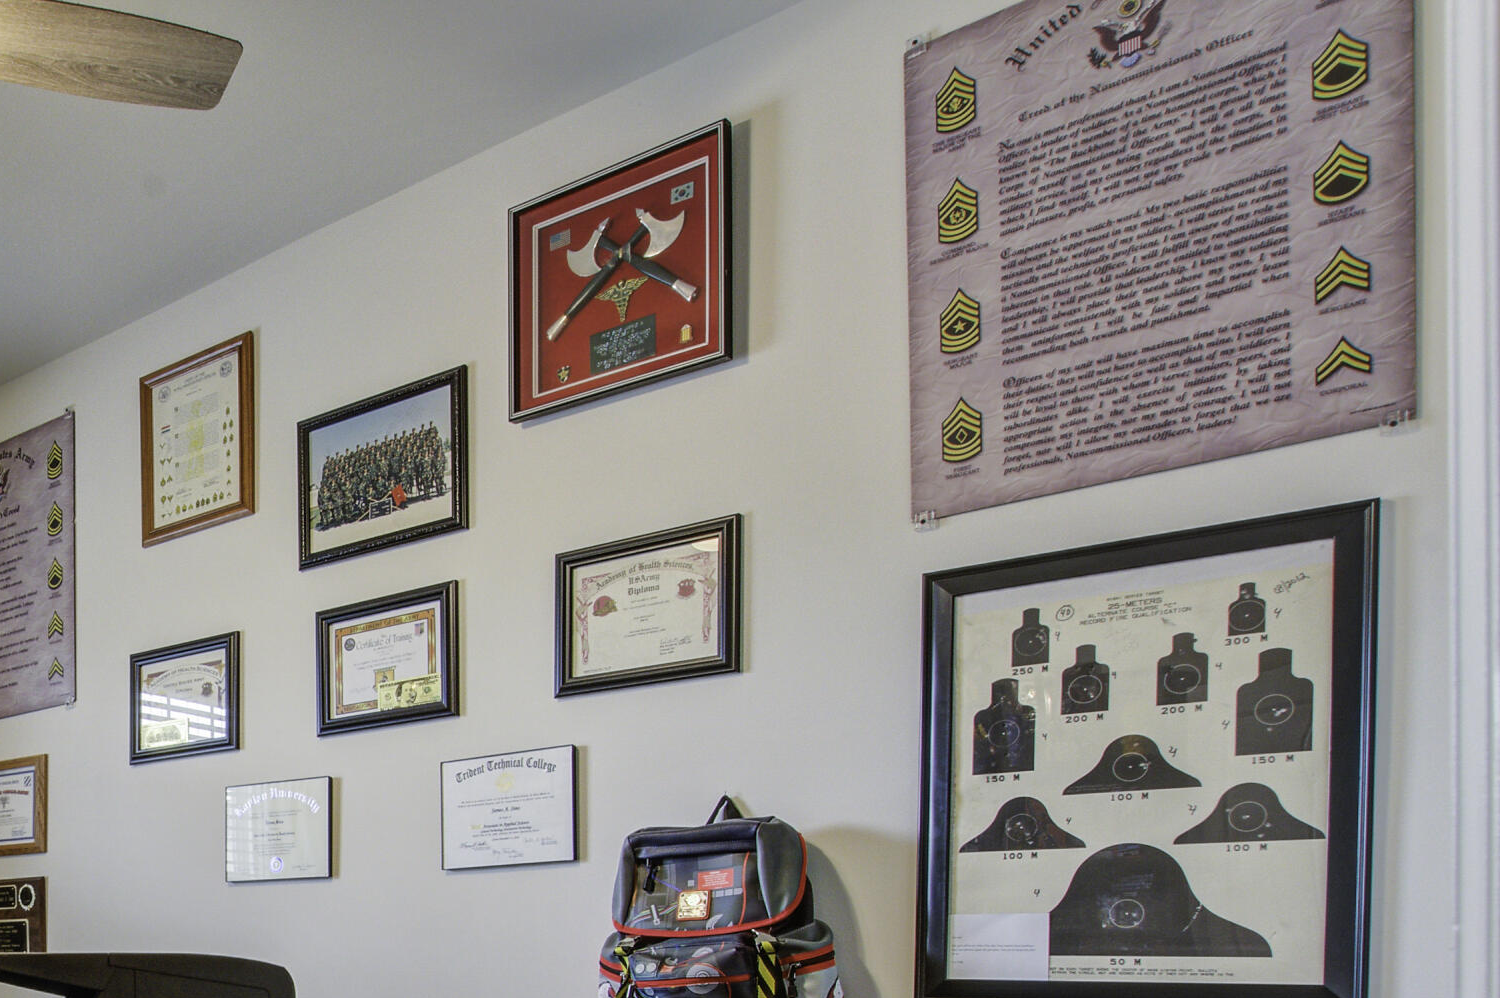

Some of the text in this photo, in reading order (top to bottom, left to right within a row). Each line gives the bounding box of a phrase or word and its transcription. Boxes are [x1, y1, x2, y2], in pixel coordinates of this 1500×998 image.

[1004, 3, 1083, 72] United
[1017, 102, 1050, 122] Creed
[1069, 91, 1085, 103] the
[1089, 48, 1202, 99] Noncommissioned
[1206, 29, 1254, 52] Officer
[15, 447, 35, 469] Army
[596, 570, 626, 590] Academy
[628, 564, 636, 574] of
[638, 561, 661, 571] Health
[628, 585, 660, 596] Diploma
[1108, 597, 1162, 610] 25-METERS
[1079, 617, 1106, 626] RECORD
[1131, 606, 1192, 619] QUALIFICATION
[1088, 608, 1127, 618] ALTERNATE
[1131, 604, 1159, 613] COURSE
[1225, 634, 1268, 646] 300 M
[1012, 665, 1049, 676] 250 M
[1161, 704, 1203, 715] 200 M
[1065, 713, 1104, 724] 200 M
[1252, 754, 1295, 765] 150 M
[455, 757, 556, 783] Trident Technical College
[985, 774, 1020, 783] 150 M
[1111, 792, 1149, 801] 100 M
[1260, 843, 1268, 851] M
[1003, 852, 1023, 860] 100
